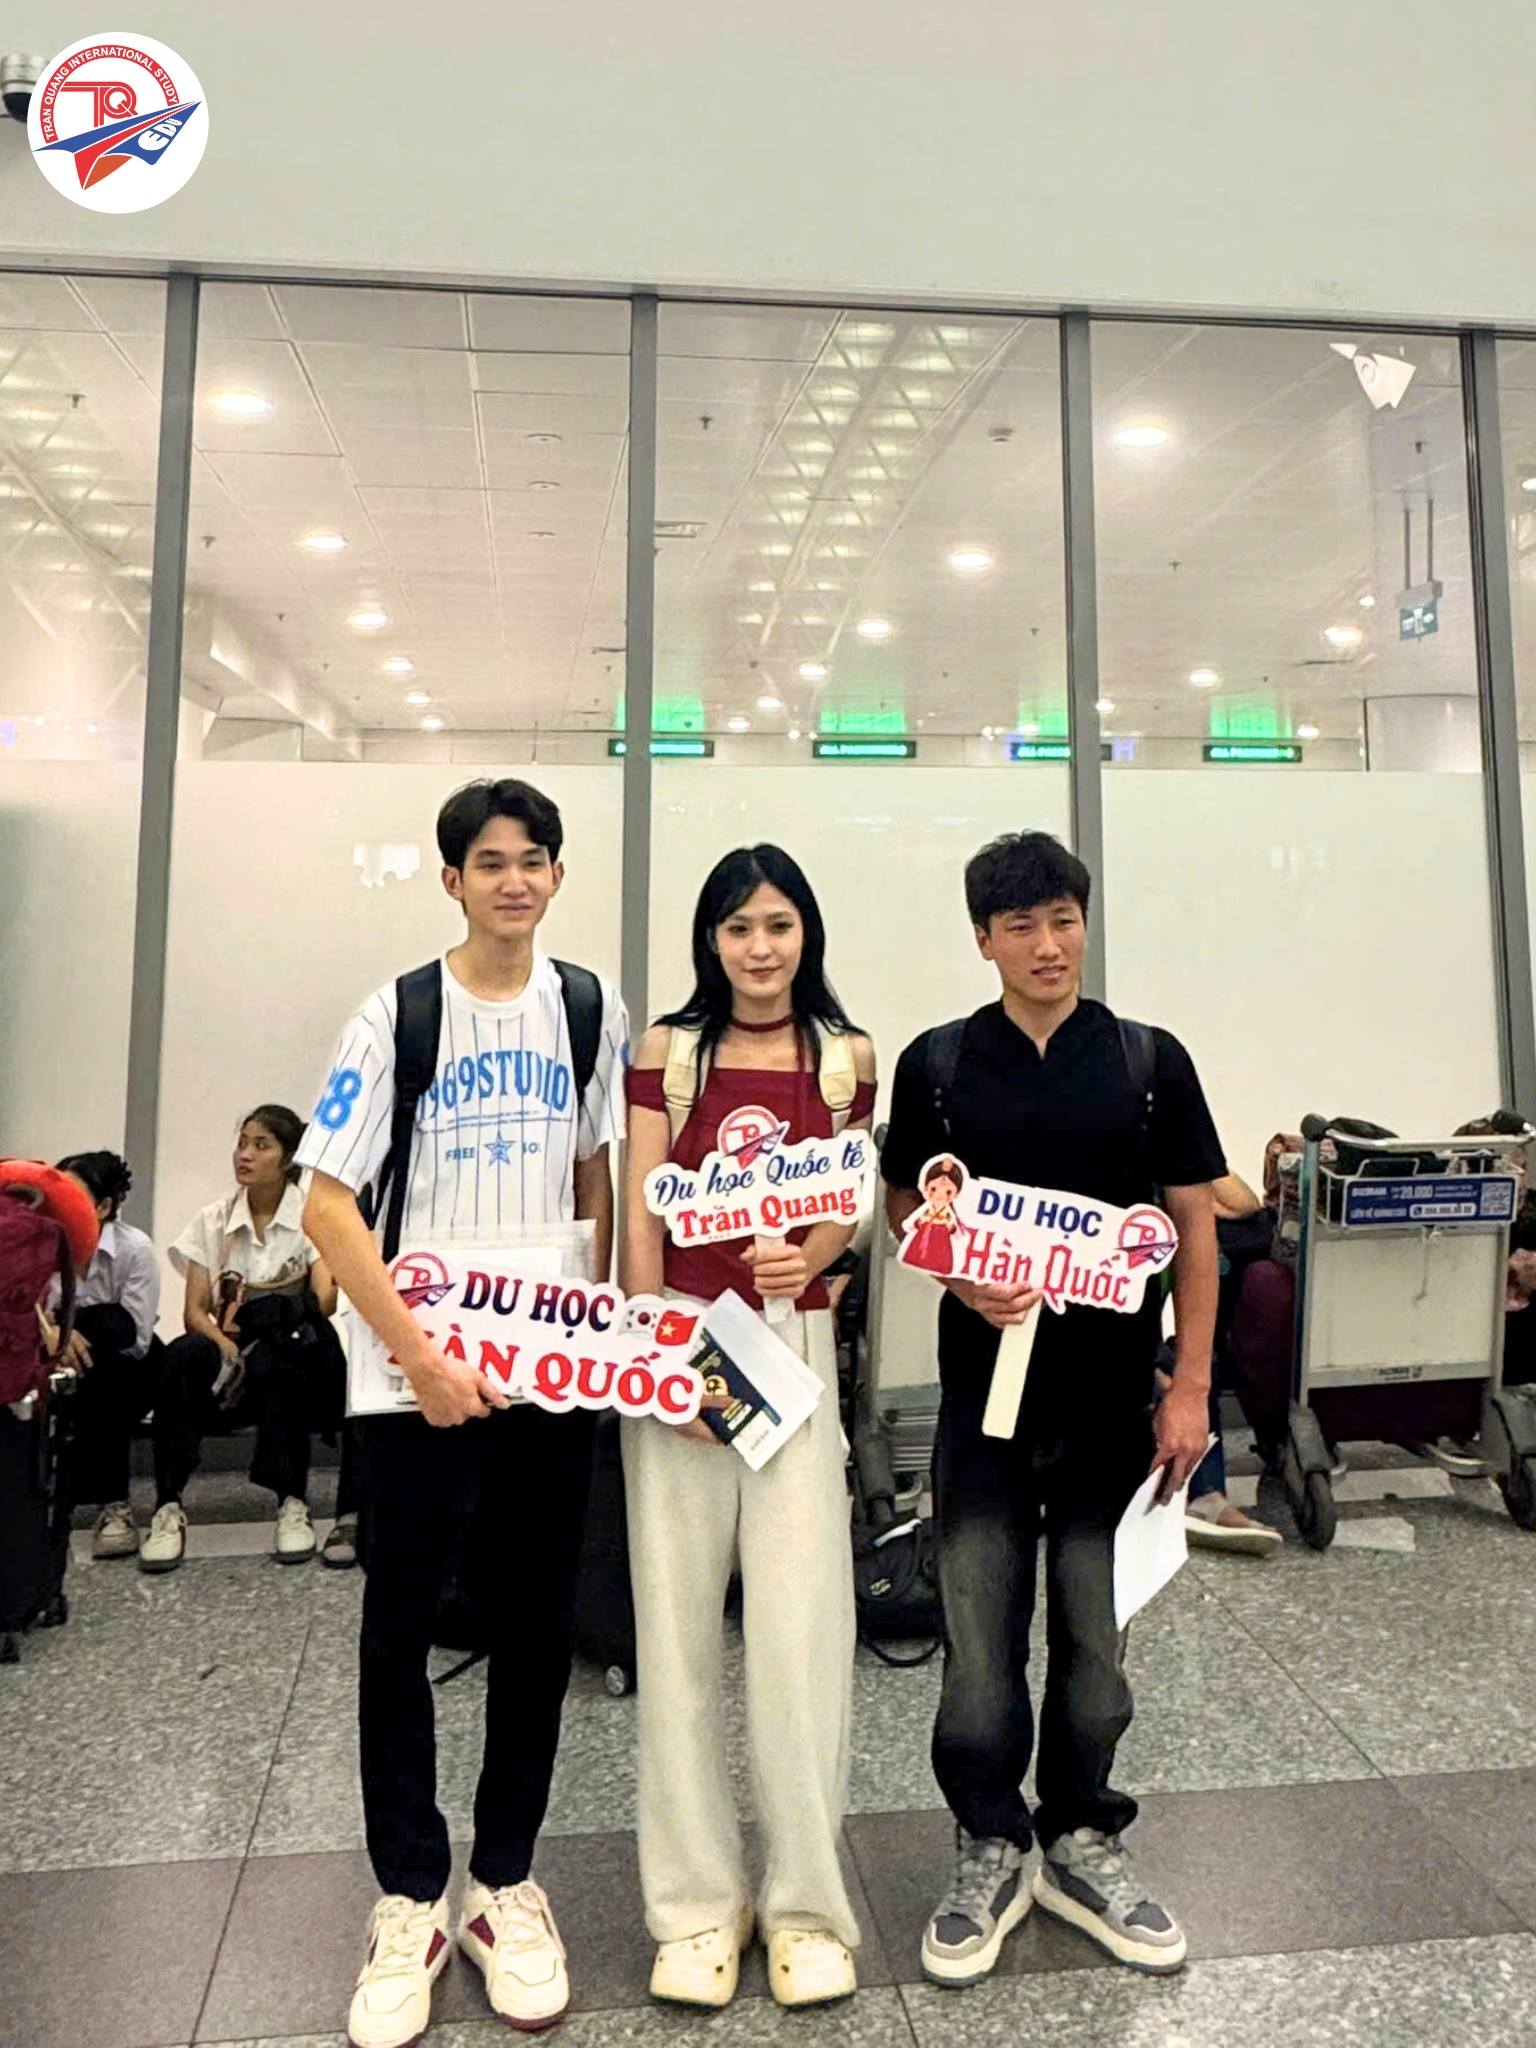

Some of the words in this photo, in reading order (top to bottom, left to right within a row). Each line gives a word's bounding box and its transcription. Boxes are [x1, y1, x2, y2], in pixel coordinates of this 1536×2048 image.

[445, 1147, 475, 1161] FREE
[655, 1174, 697, 1207] Du
[706, 1162, 755, 1197] học
[766, 1148, 832, 1187] Quốc
[841, 1139, 866, 1170] tế
[676, 1204, 752, 1238] Trần
[760, 1187, 857, 1229] Quang
[976, 1188, 1025, 1222] DU
[1034, 1200, 1103, 1240] HỌC
[960, 1226, 1033, 1284] Hàn
[1042, 1244, 1132, 1308] Quốc
[459, 1270, 523, 1315] DU
[529, 1283, 615, 1339] HỌC
[388, 1324, 520, 1383] ÀN
[532, 1351, 694, 1414] QUỐC
